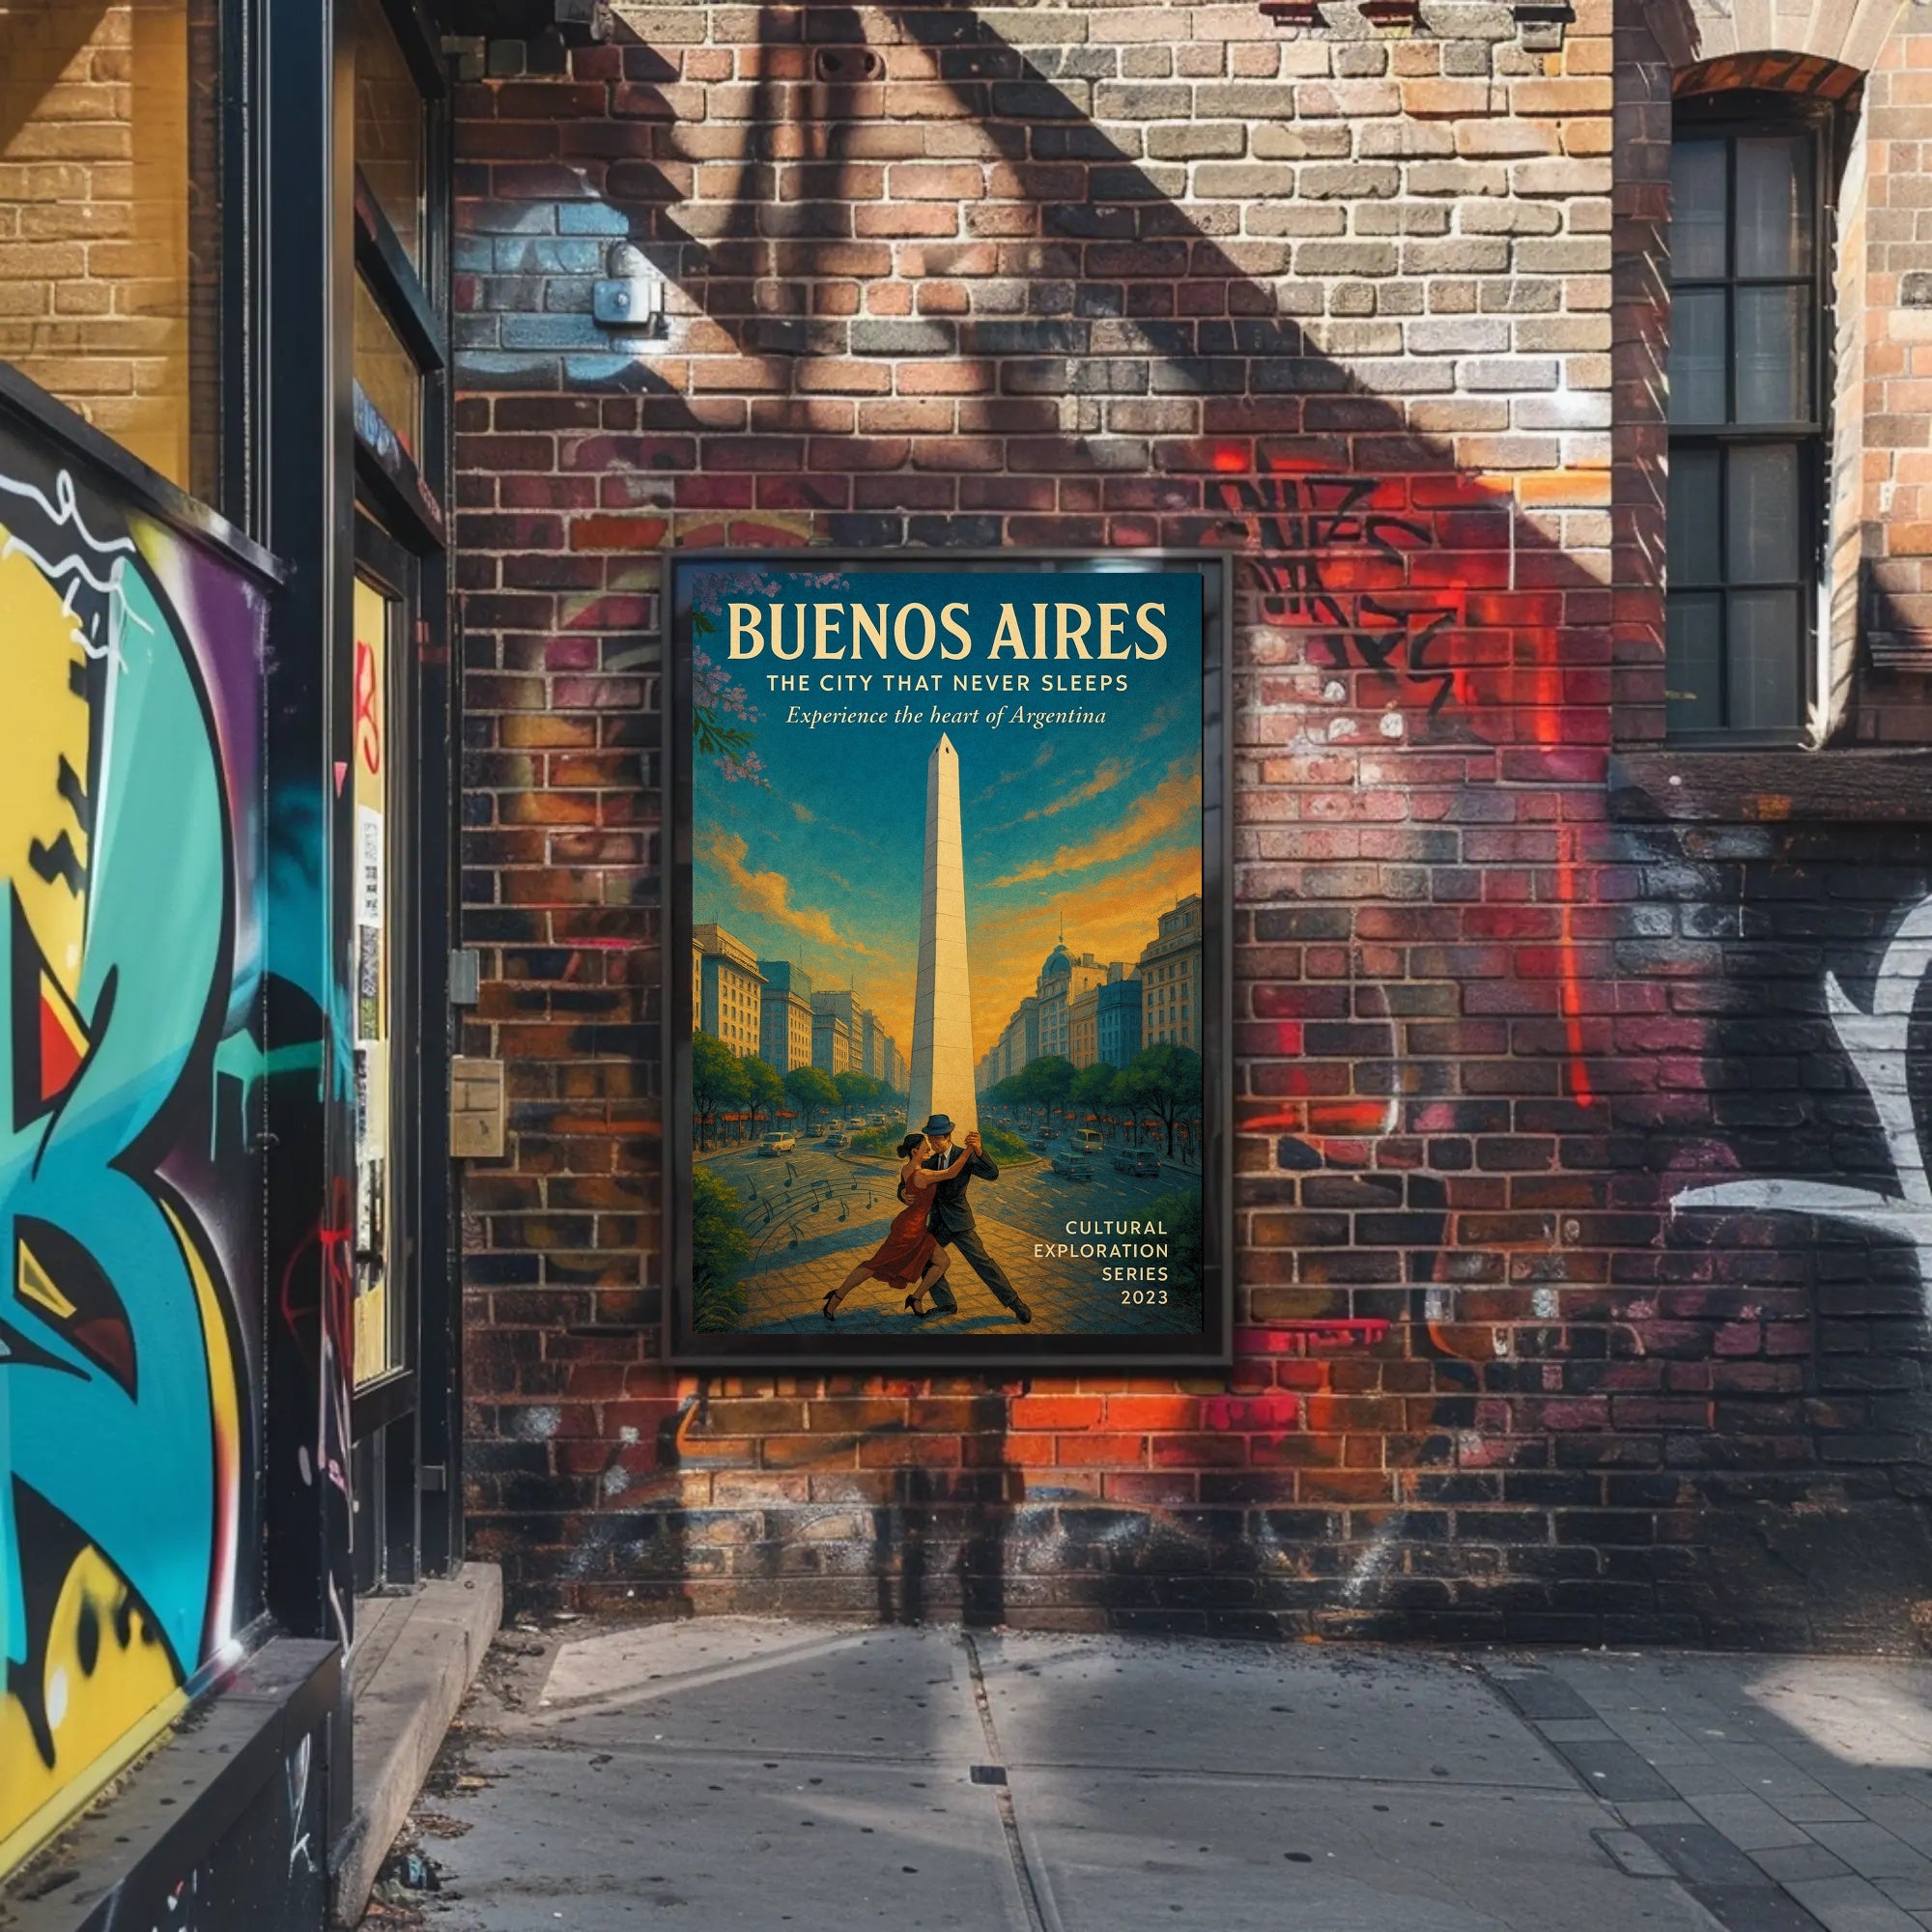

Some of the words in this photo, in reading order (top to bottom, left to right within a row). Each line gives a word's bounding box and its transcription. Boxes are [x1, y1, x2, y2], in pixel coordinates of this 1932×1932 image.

[727, 602, 972, 661] BUENOS
[987, 602, 1168, 661] AIRES
[766, 674, 810, 692] THE
[819, 674, 873, 692] CITY
[883, 674, 943, 692] THAT
[953, 674, 1030, 692] NEVER
[1041, 674, 1128, 692] SLEEPS
[785, 705, 889, 729] Experience
[895, 705, 923, 724] the
[930, 705, 980, 724] heart
[985, 704, 1009, 729] of
[1008, 705, 1106, 729] Argentina
[1065, 1220, 1168, 1235] CULTURAL
[1034, 1243, 1168, 1259] EXPLORATION
[1102, 1266, 1168, 1282] SERIES
[1122, 1290, 1168, 1305] 2023
